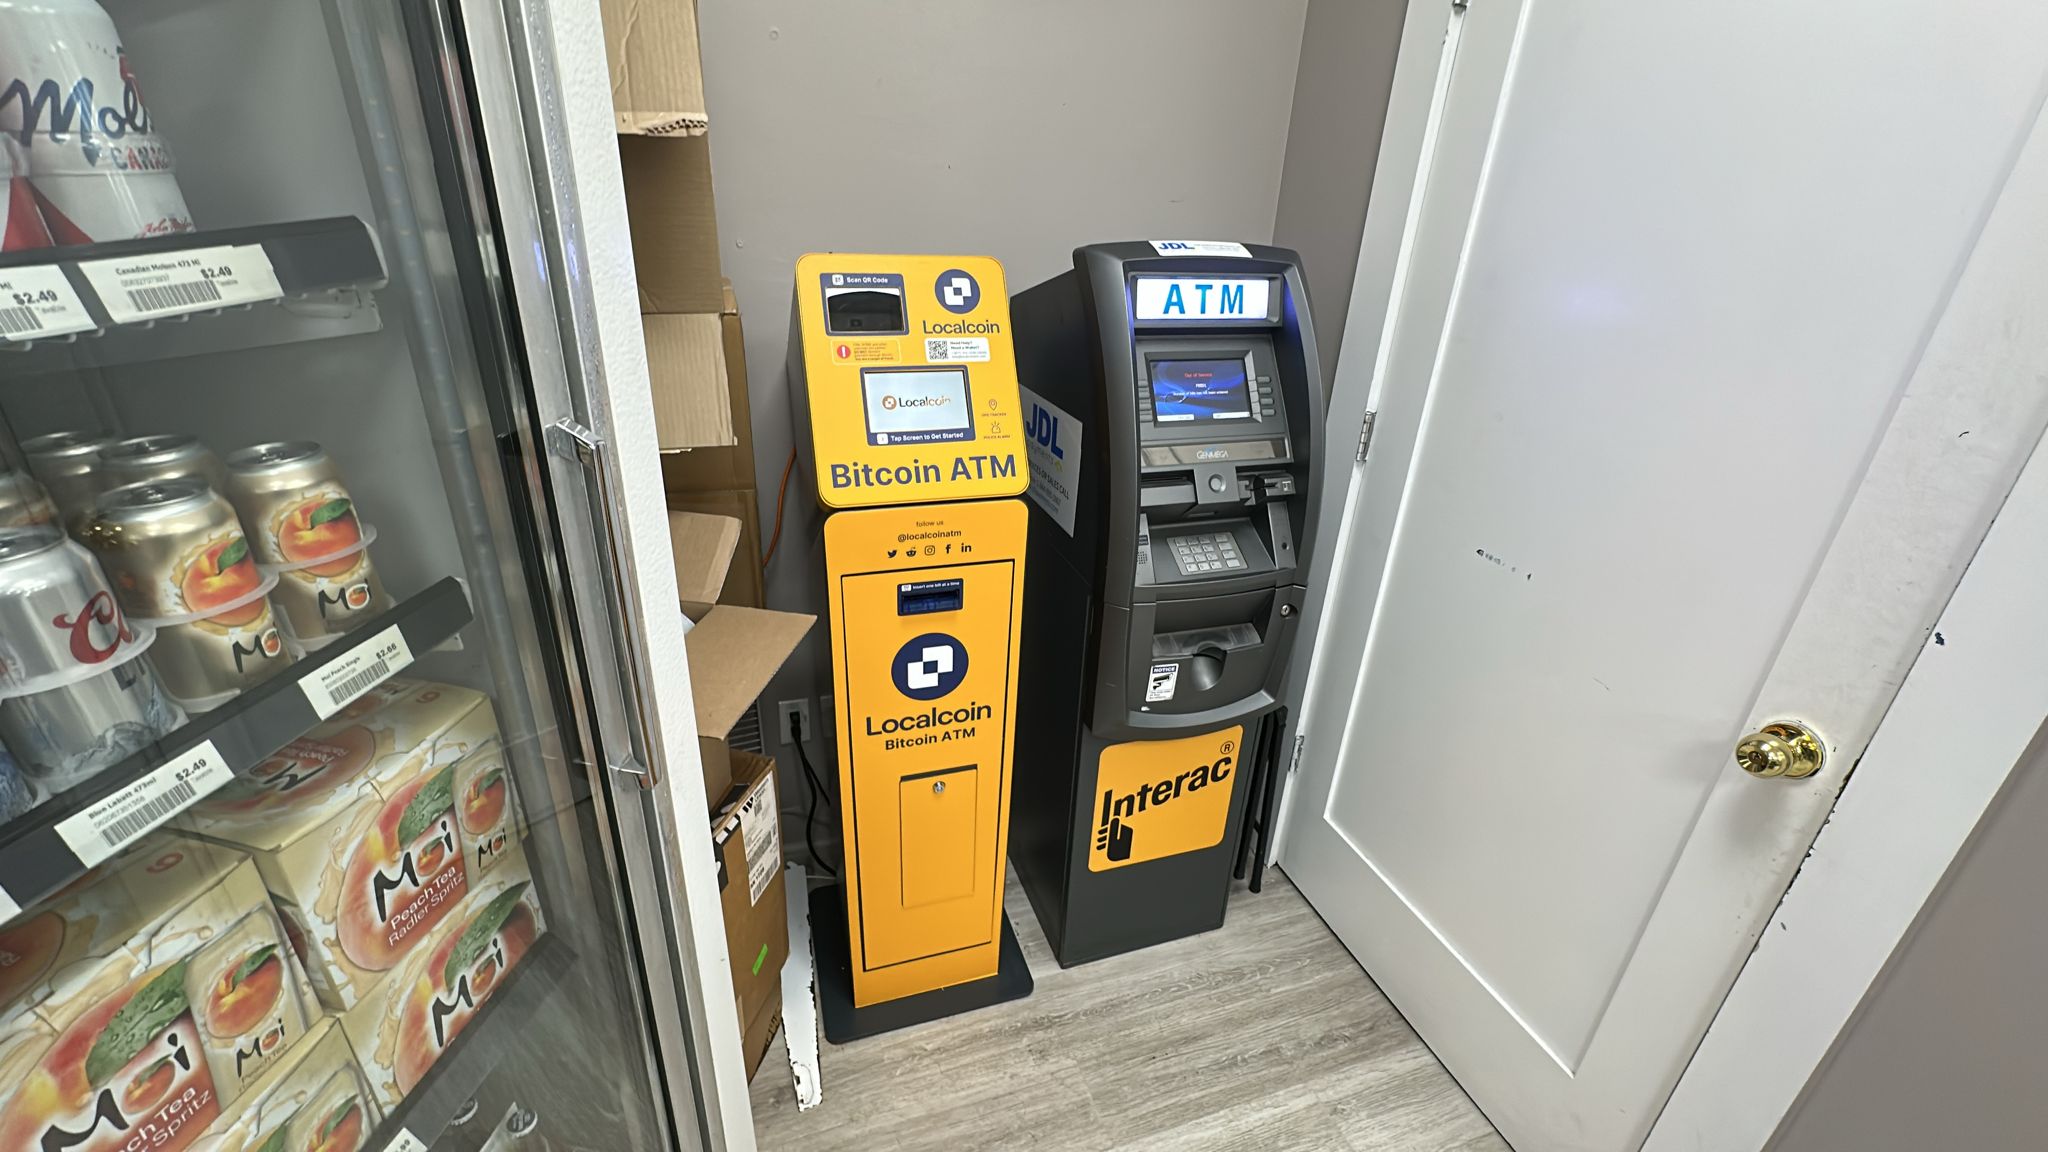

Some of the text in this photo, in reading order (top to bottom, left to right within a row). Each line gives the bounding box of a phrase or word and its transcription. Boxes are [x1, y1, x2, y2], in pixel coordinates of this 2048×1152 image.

[115, 264, 151, 275] Canadian
[200, 265, 232, 279] $2.49
[846, 276, 888, 284] Scan QR Code
[12, 290, 58, 306] $2.49
[1162, 284, 1245, 315] ATM
[922, 320, 1000, 335] Localcoin
[899, 395, 951, 408] Localcoin
[891, 431, 964, 443] Tap Screen to Get Started
[1026, 403, 1063, 459] JDL
[1196, 450, 1230, 460] GENMEGA
[830, 454, 1017, 489] Bitcoin ATM
[898, 530, 962, 542] @localcoinatm
[916, 520, 935, 528] follow
[866, 702, 992, 736] Localcoin
[885, 727, 976, 750] Bitcoin ATM
[175, 758, 207, 782] $2.49
[88, 808, 108, 820] Blue
[107, 791, 134, 810] Labatt
[133, 776, 157, 794] 473ml
[1101, 756, 1232, 827] Interac
[479, 827, 506, 868] Moi
[374, 820, 453, 923] Moi
[388, 872, 465, 947] Radler Spritz
[390, 866, 457, 930] Peach Tea
[432, 938, 503, 1048] Moi
[236, 1018, 284, 1078] Moi
[153, 1090, 211, 1147] Spritz
[154, 1087, 196, 1121] Tea
